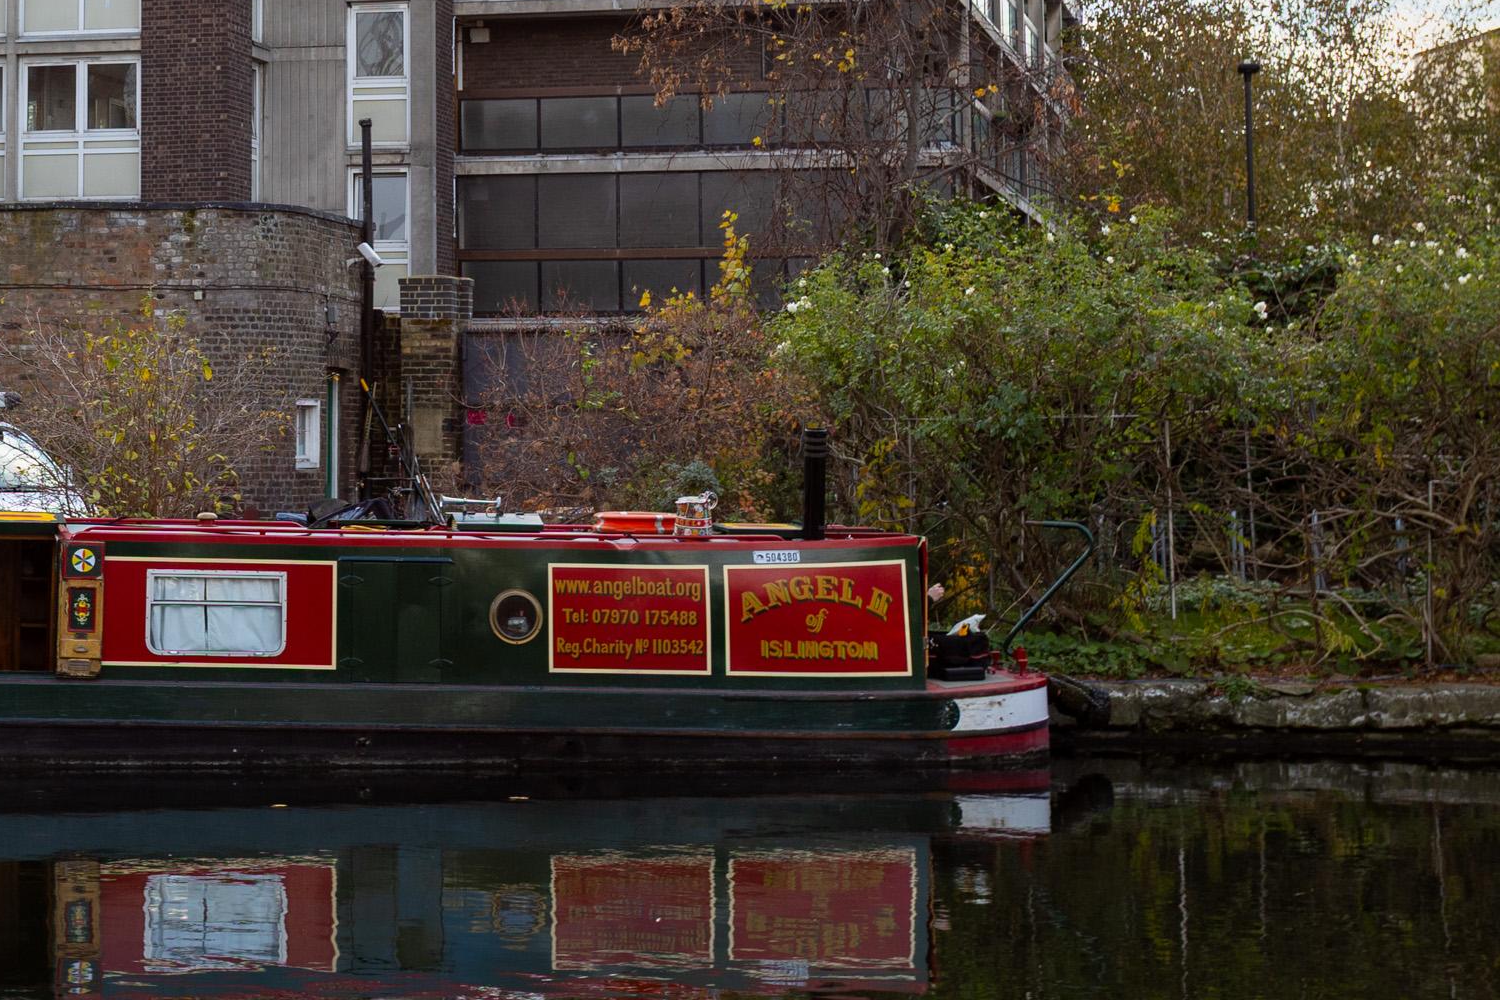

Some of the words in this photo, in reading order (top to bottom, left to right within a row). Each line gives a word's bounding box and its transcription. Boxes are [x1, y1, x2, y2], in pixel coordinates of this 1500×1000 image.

[765, 552, 798, 562] 504380
[555, 576, 701, 601] www.angelboat.org
[741, 575, 863, 622] ANGEL
[866, 587, 893, 621] II
[562, 608, 589, 623] Tel:
[592, 609, 639, 624] 07970
[645, 609, 697, 625] 175488
[805, 608, 828, 633] of
[653, 639, 704, 655] 1103542
[761, 640, 879, 660] ISLINGTON
